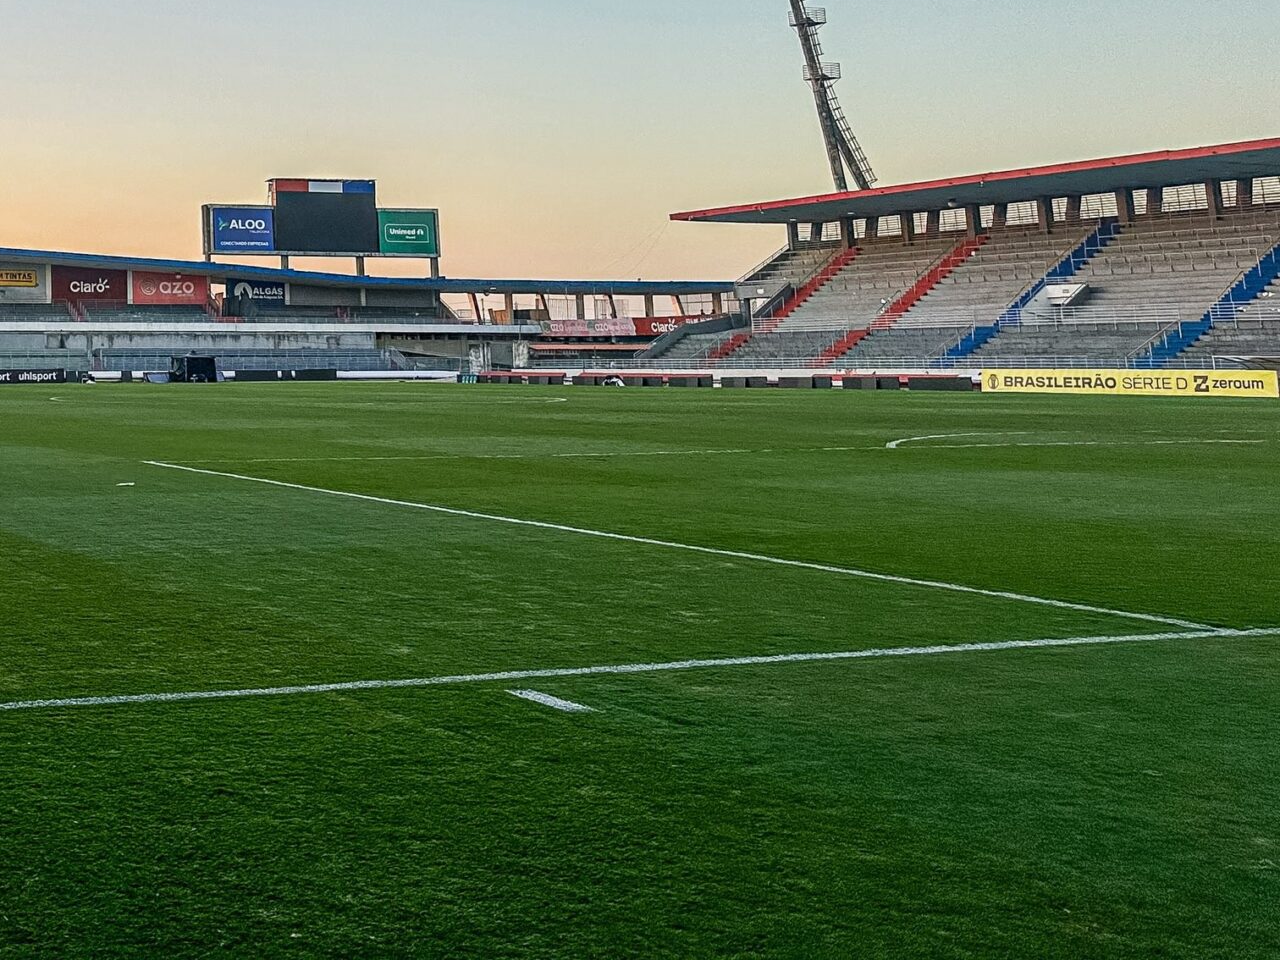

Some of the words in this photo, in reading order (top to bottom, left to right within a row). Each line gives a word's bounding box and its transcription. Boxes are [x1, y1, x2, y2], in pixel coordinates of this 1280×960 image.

[229, 219, 265, 230] ALOO
[5, 272, 33, 280] TINTAS
[70, 277, 110, 293] Claro
[159, 281, 195, 294] azo
[650, 318, 678, 333] Claro
[18, 371, 58, 382] uhlsport
[1003, 373, 1117, 389] BRASILEIRÃO
[1122, 374, 1172, 390] SÉRIE
[1176, 377, 1188, 390] D
[1211, 379, 1265, 390] zeroum
